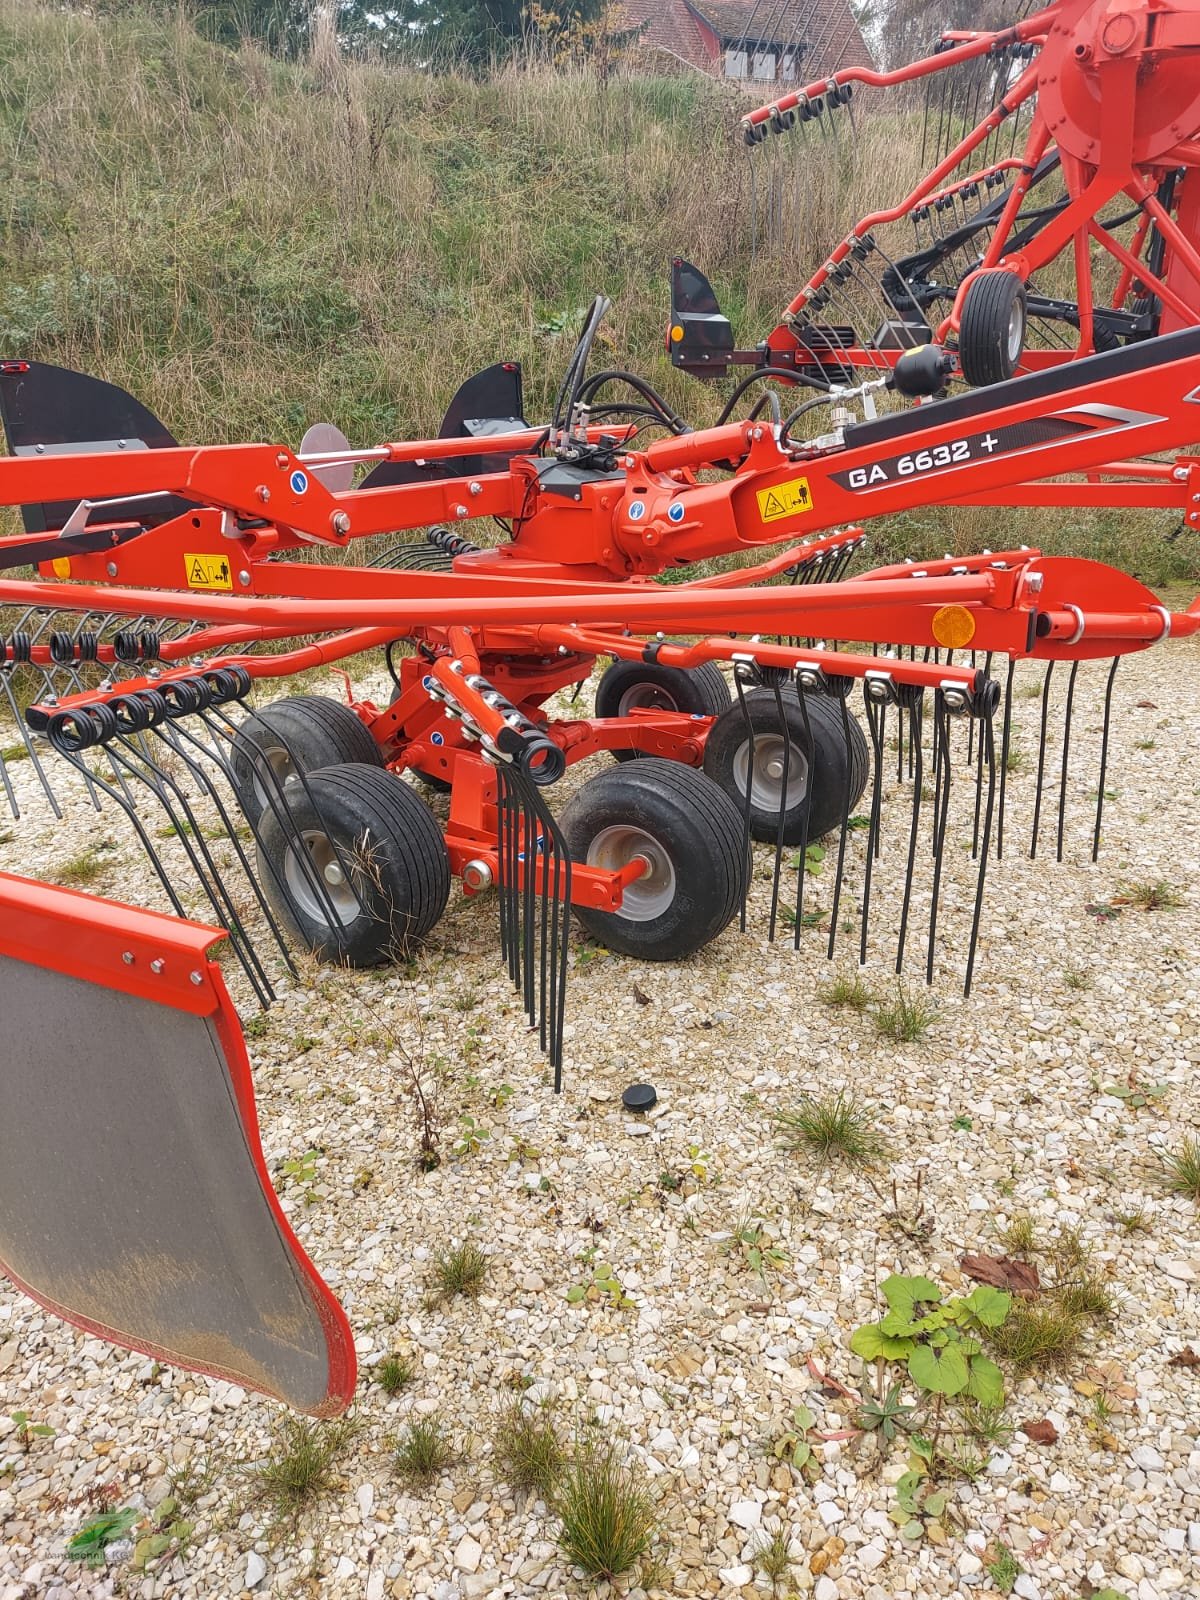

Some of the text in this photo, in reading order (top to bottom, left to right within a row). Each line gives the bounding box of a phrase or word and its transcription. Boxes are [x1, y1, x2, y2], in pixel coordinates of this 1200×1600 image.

[848, 434, 999, 488] GA 6632 +
